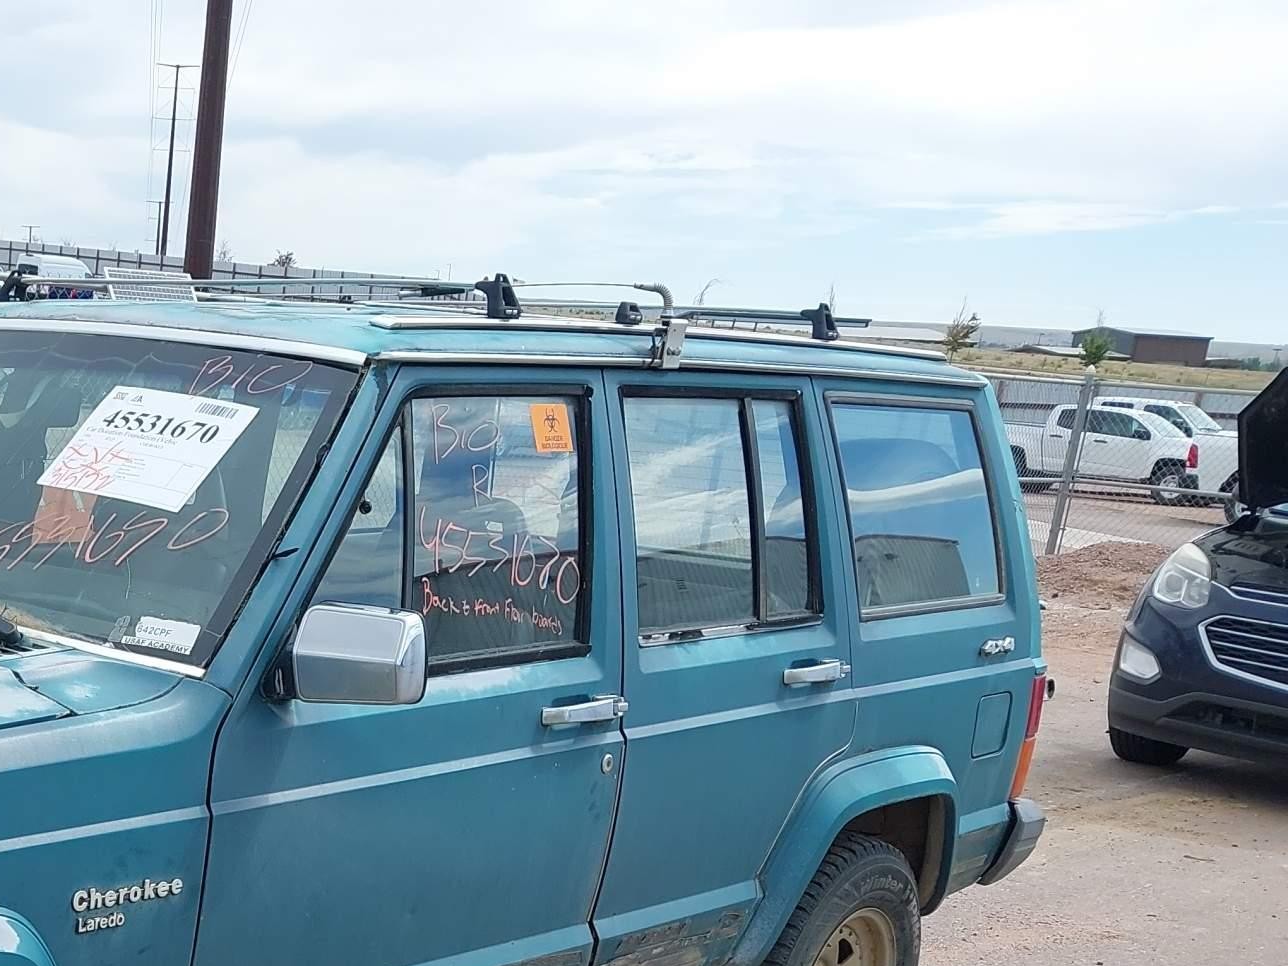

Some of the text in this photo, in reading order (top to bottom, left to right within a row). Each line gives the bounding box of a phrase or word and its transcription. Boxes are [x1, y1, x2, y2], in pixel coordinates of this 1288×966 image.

[103, 409, 220, 445] 45531670
[422, 577, 460, 616] Back
[123, 636, 190, 654] USAF ACADEMY
[136, 624, 173, 638] 642CPF
[72, 878, 184, 912] Cherokee
[76, 911, 126, 933] Laredo
